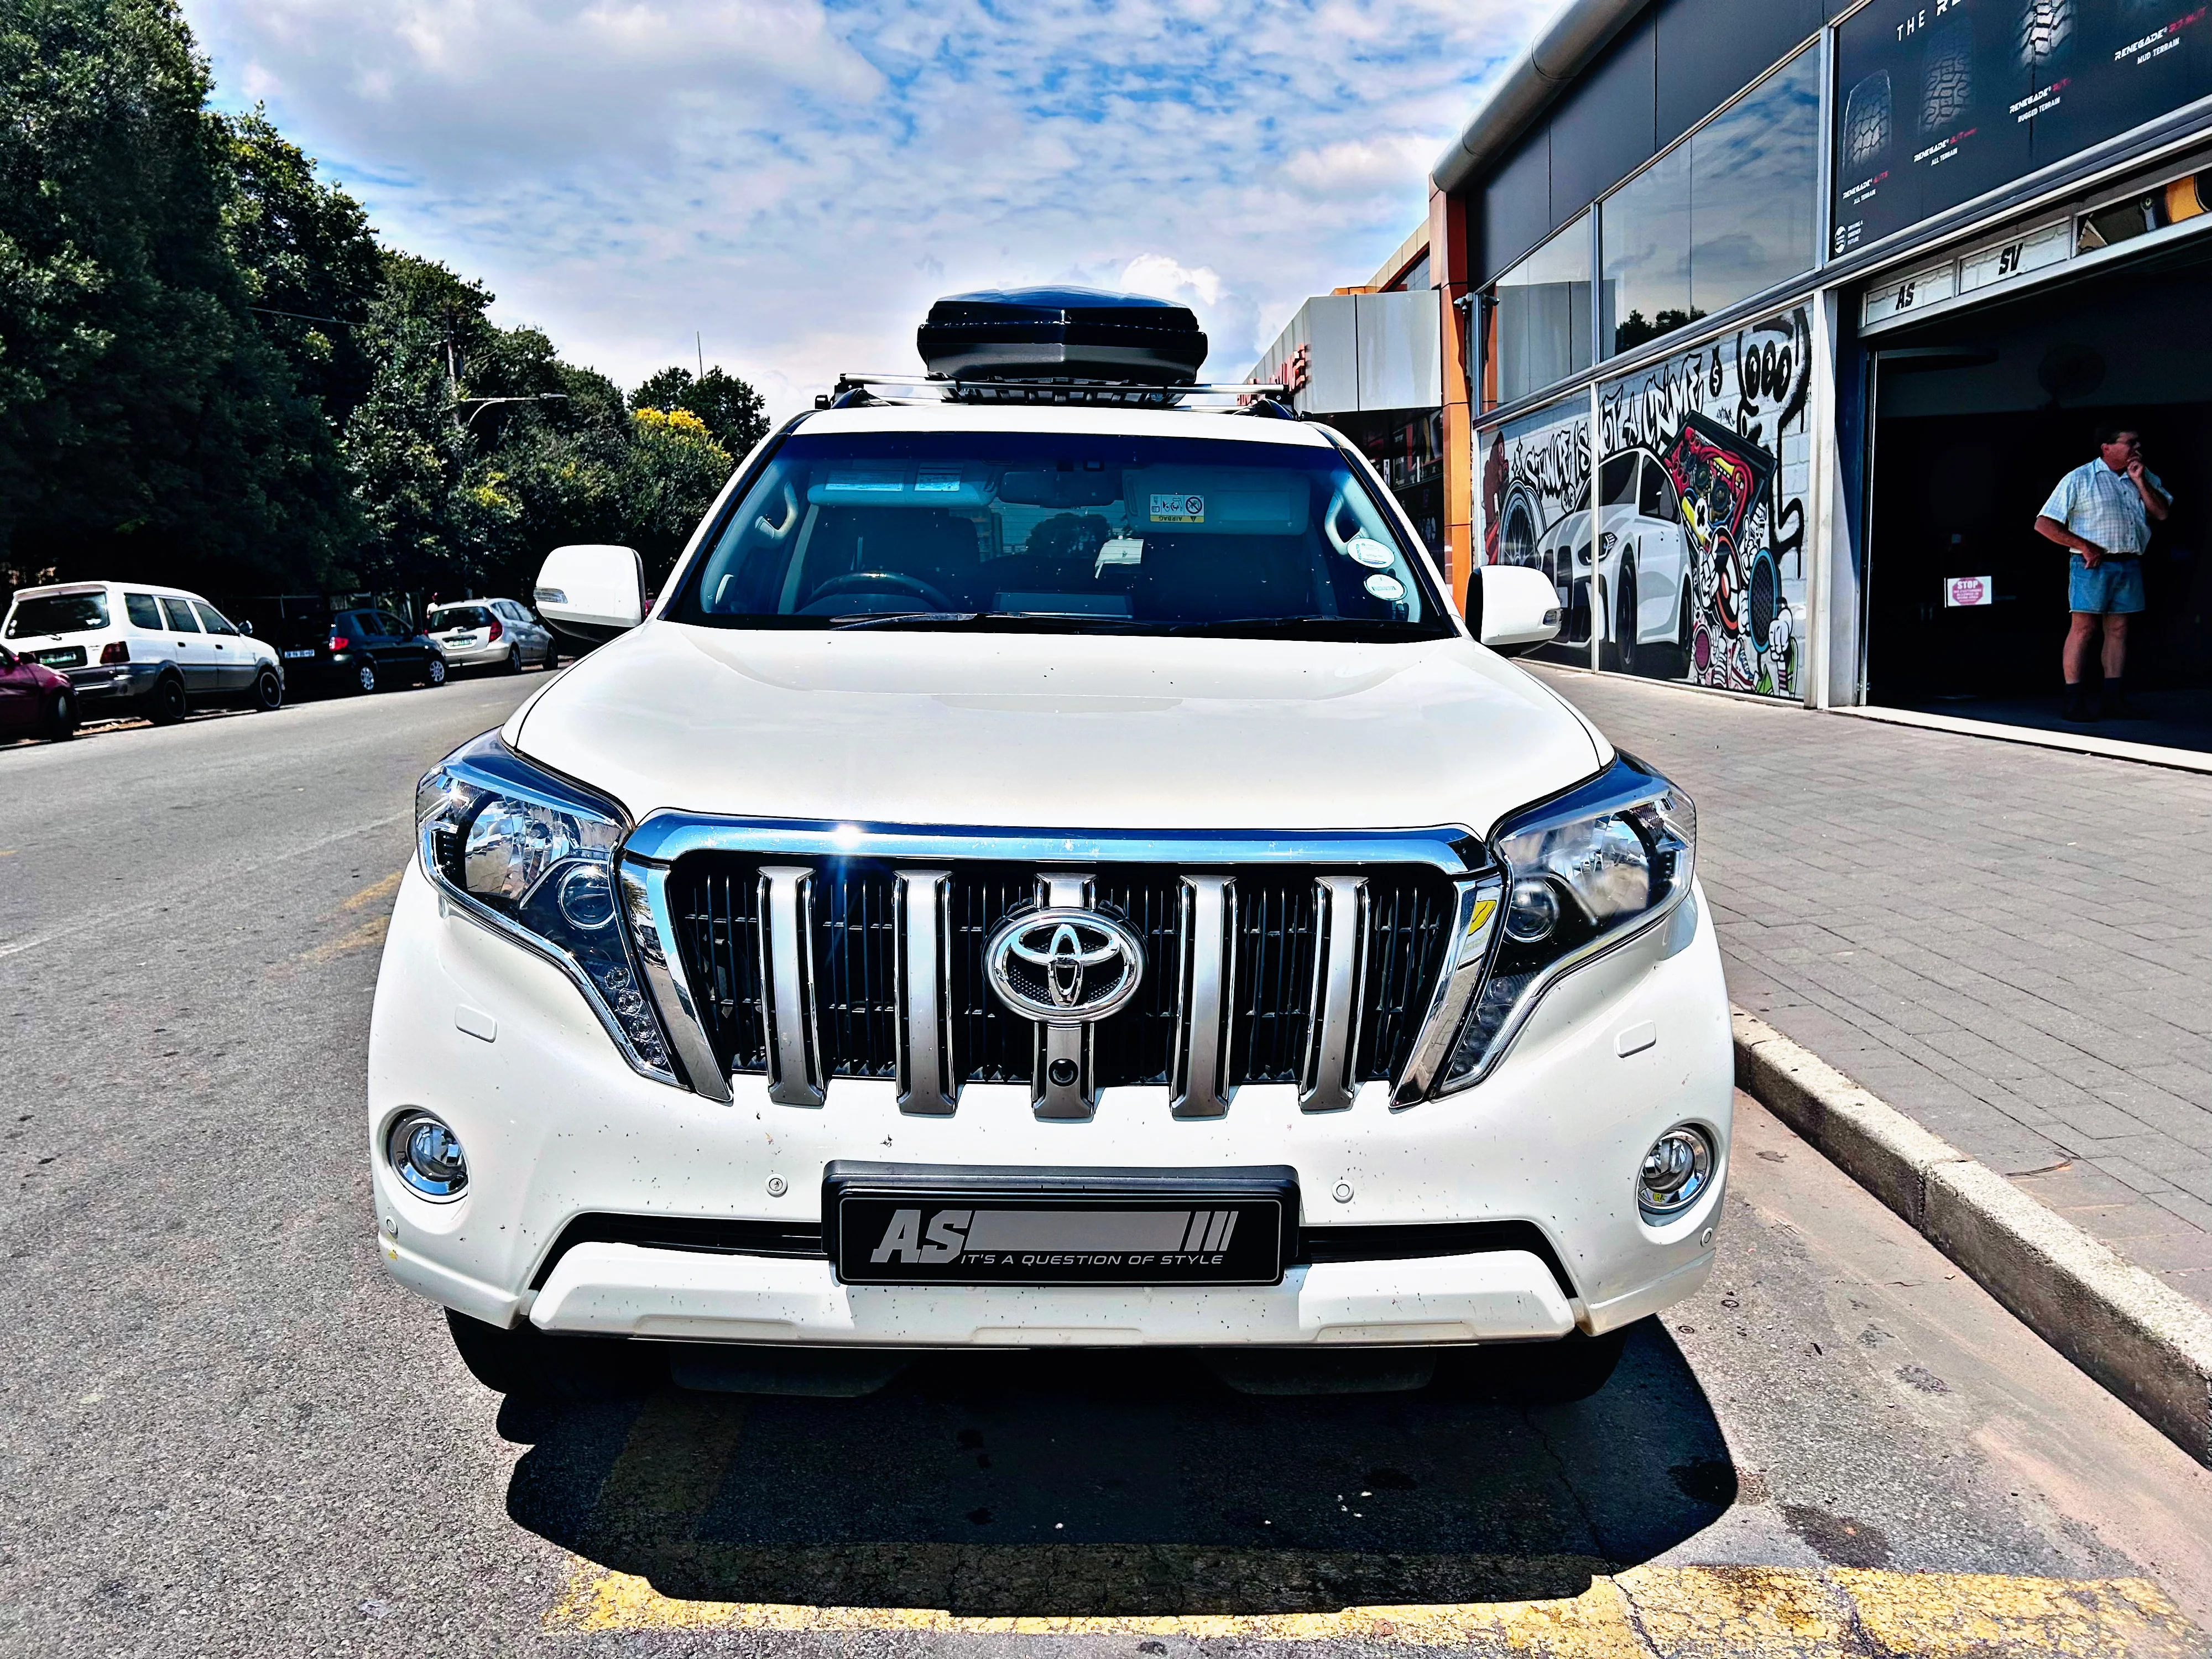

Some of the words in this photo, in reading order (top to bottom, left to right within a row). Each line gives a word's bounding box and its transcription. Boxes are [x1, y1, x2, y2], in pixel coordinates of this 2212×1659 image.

[1897, 9, 1925, 41] THE
[2114, 27, 2167, 61] RENEGADE
[2137, 51, 2151, 64] MUD
[2152, 37, 2180, 56] TERRAIN
[2010, 87, 2049, 114] RENEGADE
[2039, 96, 2060, 112] TERRAIN
[1999, 242, 2024, 275] SV
[1895, 282, 1915, 310] AS
[1574, 420, 1592, 487] IS
[1623, 392, 1639, 446] A
[1642, 353, 1704, 450] CRIME
[1957, 580, 1979, 589] STOP
[870, 1209, 972, 1263] AS
[961, 1254, 995, 1264] IT'S
[1001, 1255, 1014, 1264] A
[1021, 1255, 1121, 1266] QUESTION
[1128, 1255, 1155, 1265] OF
[1160, 1255, 1223, 1265] STYLE
